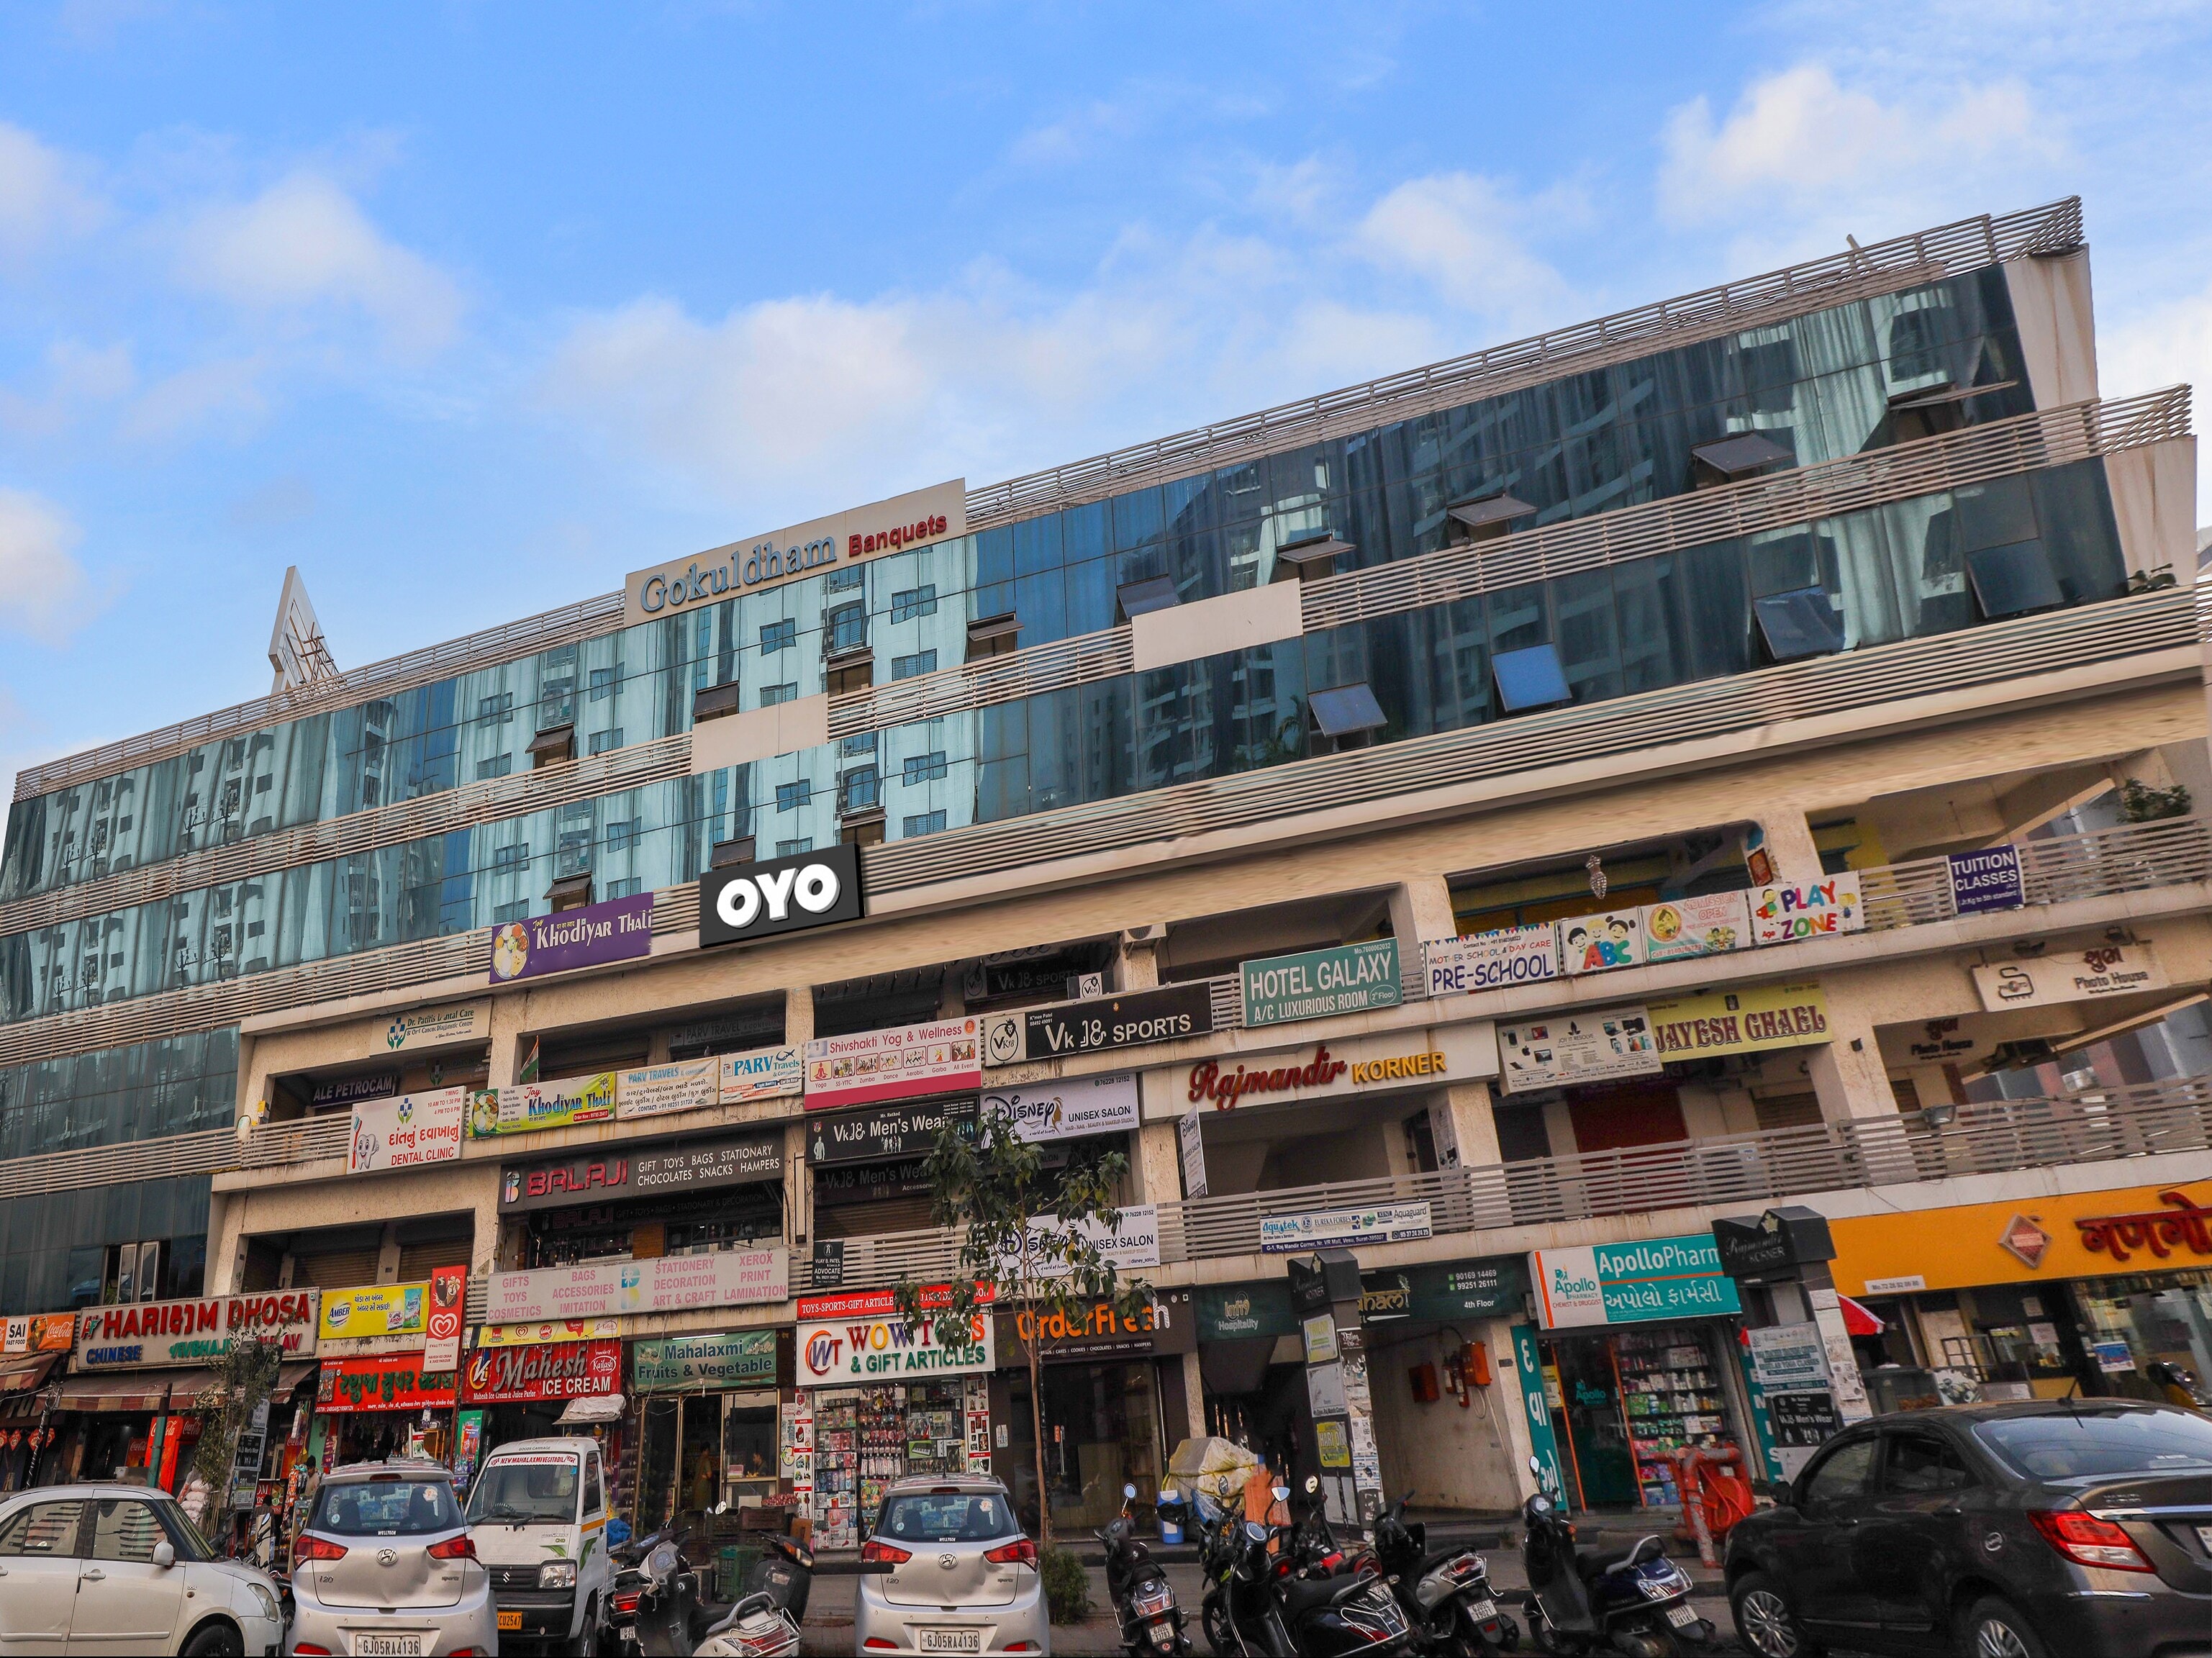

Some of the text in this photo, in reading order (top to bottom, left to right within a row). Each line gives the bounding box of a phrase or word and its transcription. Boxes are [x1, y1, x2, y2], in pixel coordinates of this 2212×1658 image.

[640, 515, 947, 612] Gokuldham Banquets
[1952, 851, 2014, 876] TUITION
[1955, 870, 2017, 892] CLASSES
[717, 864, 842, 928] OYO
[1684, 892, 1738, 910] ADMISSION
[1781, 881, 1836, 912] PLAY
[1698, 906, 1726, 920] OPEN
[533, 919, 544, 931] Jay
[1781, 913, 1837, 939] ZONE
[1429, 953, 1464, 965] MOTHER
[1467, 948, 1500, 960] SCHOOL
[1509, 943, 1526, 952] DAY
[1530, 940, 1551, 949] CARE
[1583, 938, 1633, 969] ABC
[1251, 952, 1392, 1001] HOTEL GALAXY
[1433, 954, 1554, 992] PRE-SCHOOL
[2074, 977, 2110, 990] Photo
[2111, 971, 2149, 984] House
[1254, 990, 1367, 1022] A/C LUXURIOUS ROOM
[830, 1025, 962, 1054] Shivshakti Yog & Wellness
[1113, 1014, 1191, 1042] SPORTS
[1656, 1005, 1827, 1051] JAYESH GHAEL
[734, 1055, 774, 1077] PARV
[774, 1059, 799, 1070] Travels
[335, 1077, 393, 1098] PETROCAM
[1116, 1075, 1130, 1084] 12152
[1188, 1046, 1447, 1111] Rajmandir KORNER
[525, 1087, 542, 1099] Jay
[1068, 1105, 1131, 1123] UNISEX SALON
[389, 1118, 461, 1149] દાંતનું દવાખાનું
[870, 1118, 908, 1137] Men's
[391, 1146, 454, 1167] DENTAL CLINIC
[638, 1145, 773, 1174] GIFT TOYS BAGS STATIONARY
[527, 1160, 628, 1197] BALAJI
[638, 1159, 780, 1187] CHOCOLATES SNACKS HAMPERS
[1394, 1207, 1427, 1219] Aquaguard
[1120, 1235, 1153, 1247] SALON
[502, 1254, 774, 1288] GIFTS BAGS STATIONERY XEROX
[1456, 1269, 1497, 1281] 90169 14469
[504, 1269, 771, 1303] TOYS ACCESSORIES DECORATION PRINT
[1457, 1282, 1477, 1290] 99251
[1555, 1277, 1596, 1300] Apollo
[1604, 1282, 1664, 1310] અપોલો
[227, 1293, 311, 1328] DHOSA
[488, 1285, 787, 1320] COSMETICS IMITATION ART & CRAFT LAMINATION
[9, 1323, 26, 1338] SAI
[846, 1322, 912, 1351] WOW
[1218, 1318, 1259, 1332] Hospitality
[86, 1344, 142, 1364] CHINESE
[665, 1339, 743, 1361] Mahalaxmi
[851, 1346, 986, 1373] & GIFT ARTICLES
[493, 1346, 588, 1392] Mahesh
[592, 1359, 614, 1369] Kailash
[638, 1359, 773, 1380] Fruits & Vegetable
[382, 1370, 414, 1401] સુપર
[543, 1377, 612, 1395] ICE CREAM
[1576, 1390, 1606, 1405] Apollo
[363, 1640, 419, 1654] GJ05RA4136
[927, 1633, 979, 1650] GJ05RA4136
